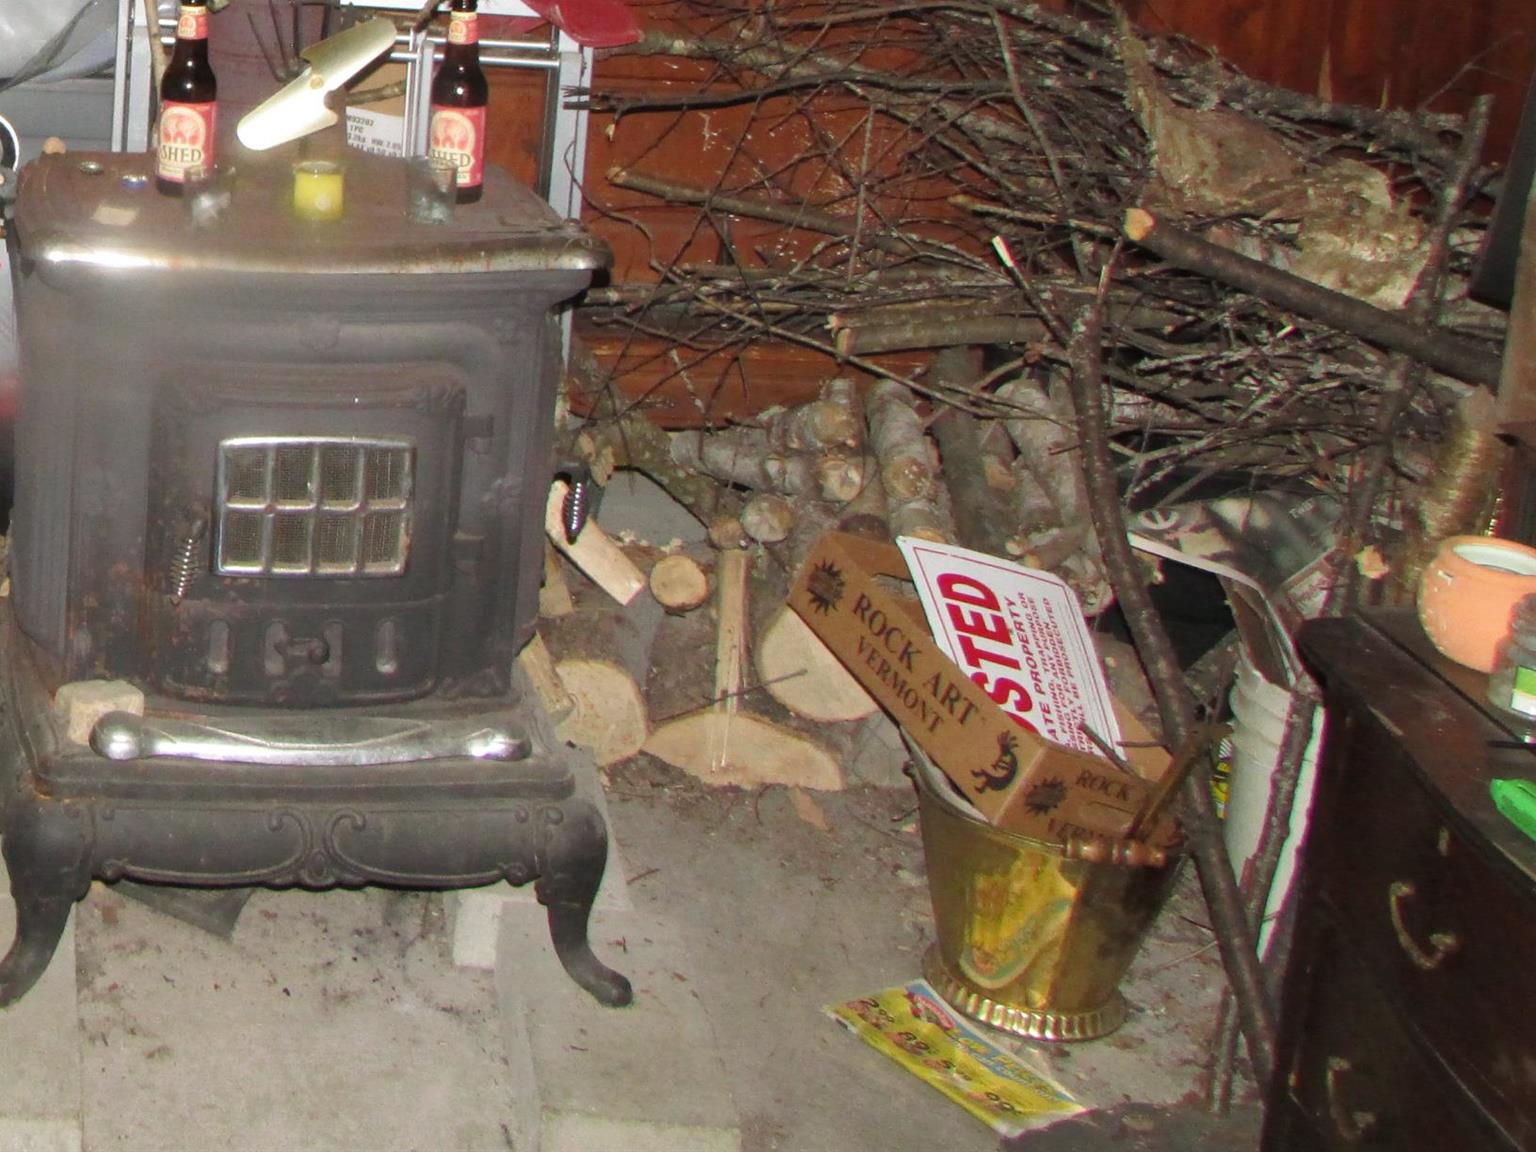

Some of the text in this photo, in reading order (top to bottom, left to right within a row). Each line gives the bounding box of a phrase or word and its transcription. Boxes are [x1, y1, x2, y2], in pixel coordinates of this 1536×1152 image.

[160, 144, 202, 164] SHED
[852, 592, 980, 726] ROCK ART
[856, 635, 945, 733] VERMONT
[1005, 597, 1046, 695] PROPERTY
[1075, 768, 1131, 801] ROCK
